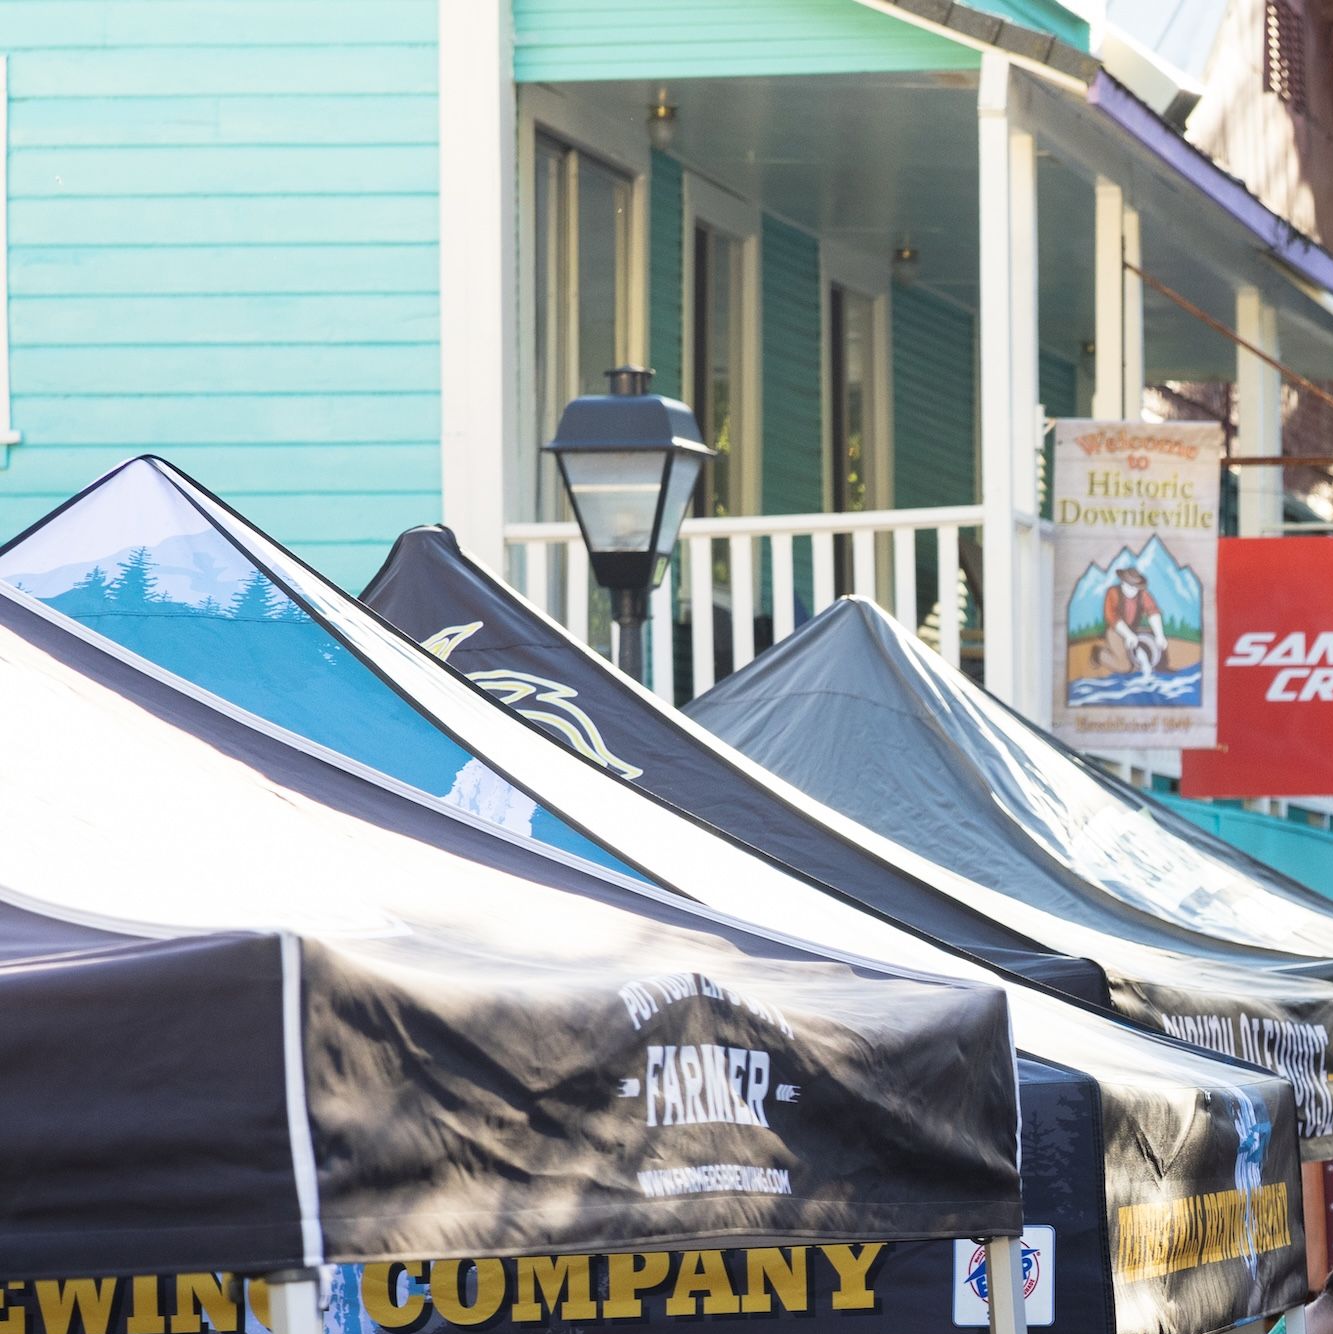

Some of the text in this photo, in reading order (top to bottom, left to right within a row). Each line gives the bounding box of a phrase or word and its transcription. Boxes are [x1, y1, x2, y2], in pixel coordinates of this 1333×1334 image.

[1075, 429, 1199, 462] Welcome
[1127, 454, 1150, 471] to
[1087, 471, 1195, 499] Historic
[1056, 498, 1214, 529] Downieville
[646, 1044, 771, 1128] FARMER
[361, 1242, 888, 1328] COMPANY
